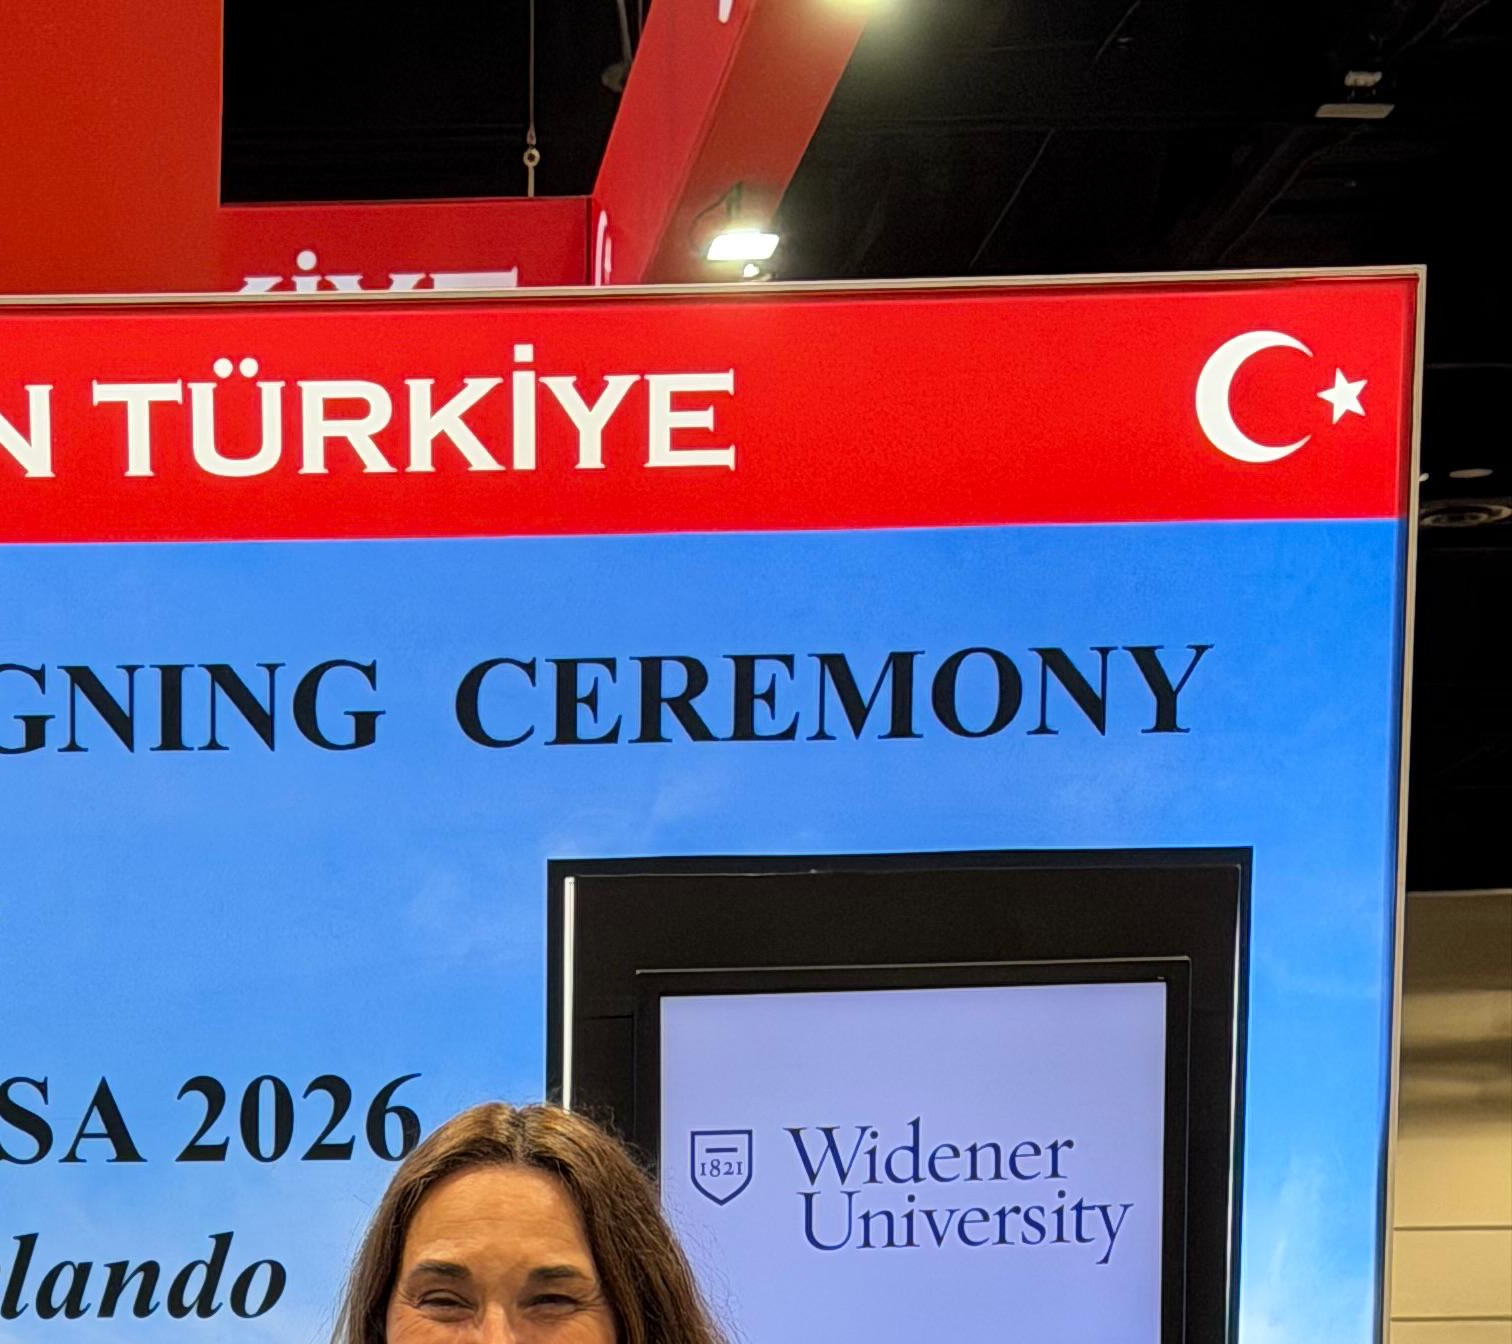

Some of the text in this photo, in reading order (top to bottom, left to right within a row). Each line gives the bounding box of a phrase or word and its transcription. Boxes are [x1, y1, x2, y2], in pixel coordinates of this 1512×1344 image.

[92, 344, 735, 478] TÜRKİYE
[454, 643, 1215, 748] CEREMONY
[175, 1073, 422, 1164] 2026
[783, 1116, 1074, 1187] Widener
[700, 1158, 743, 1178] 1821
[797, 1190, 1134, 1265] University
